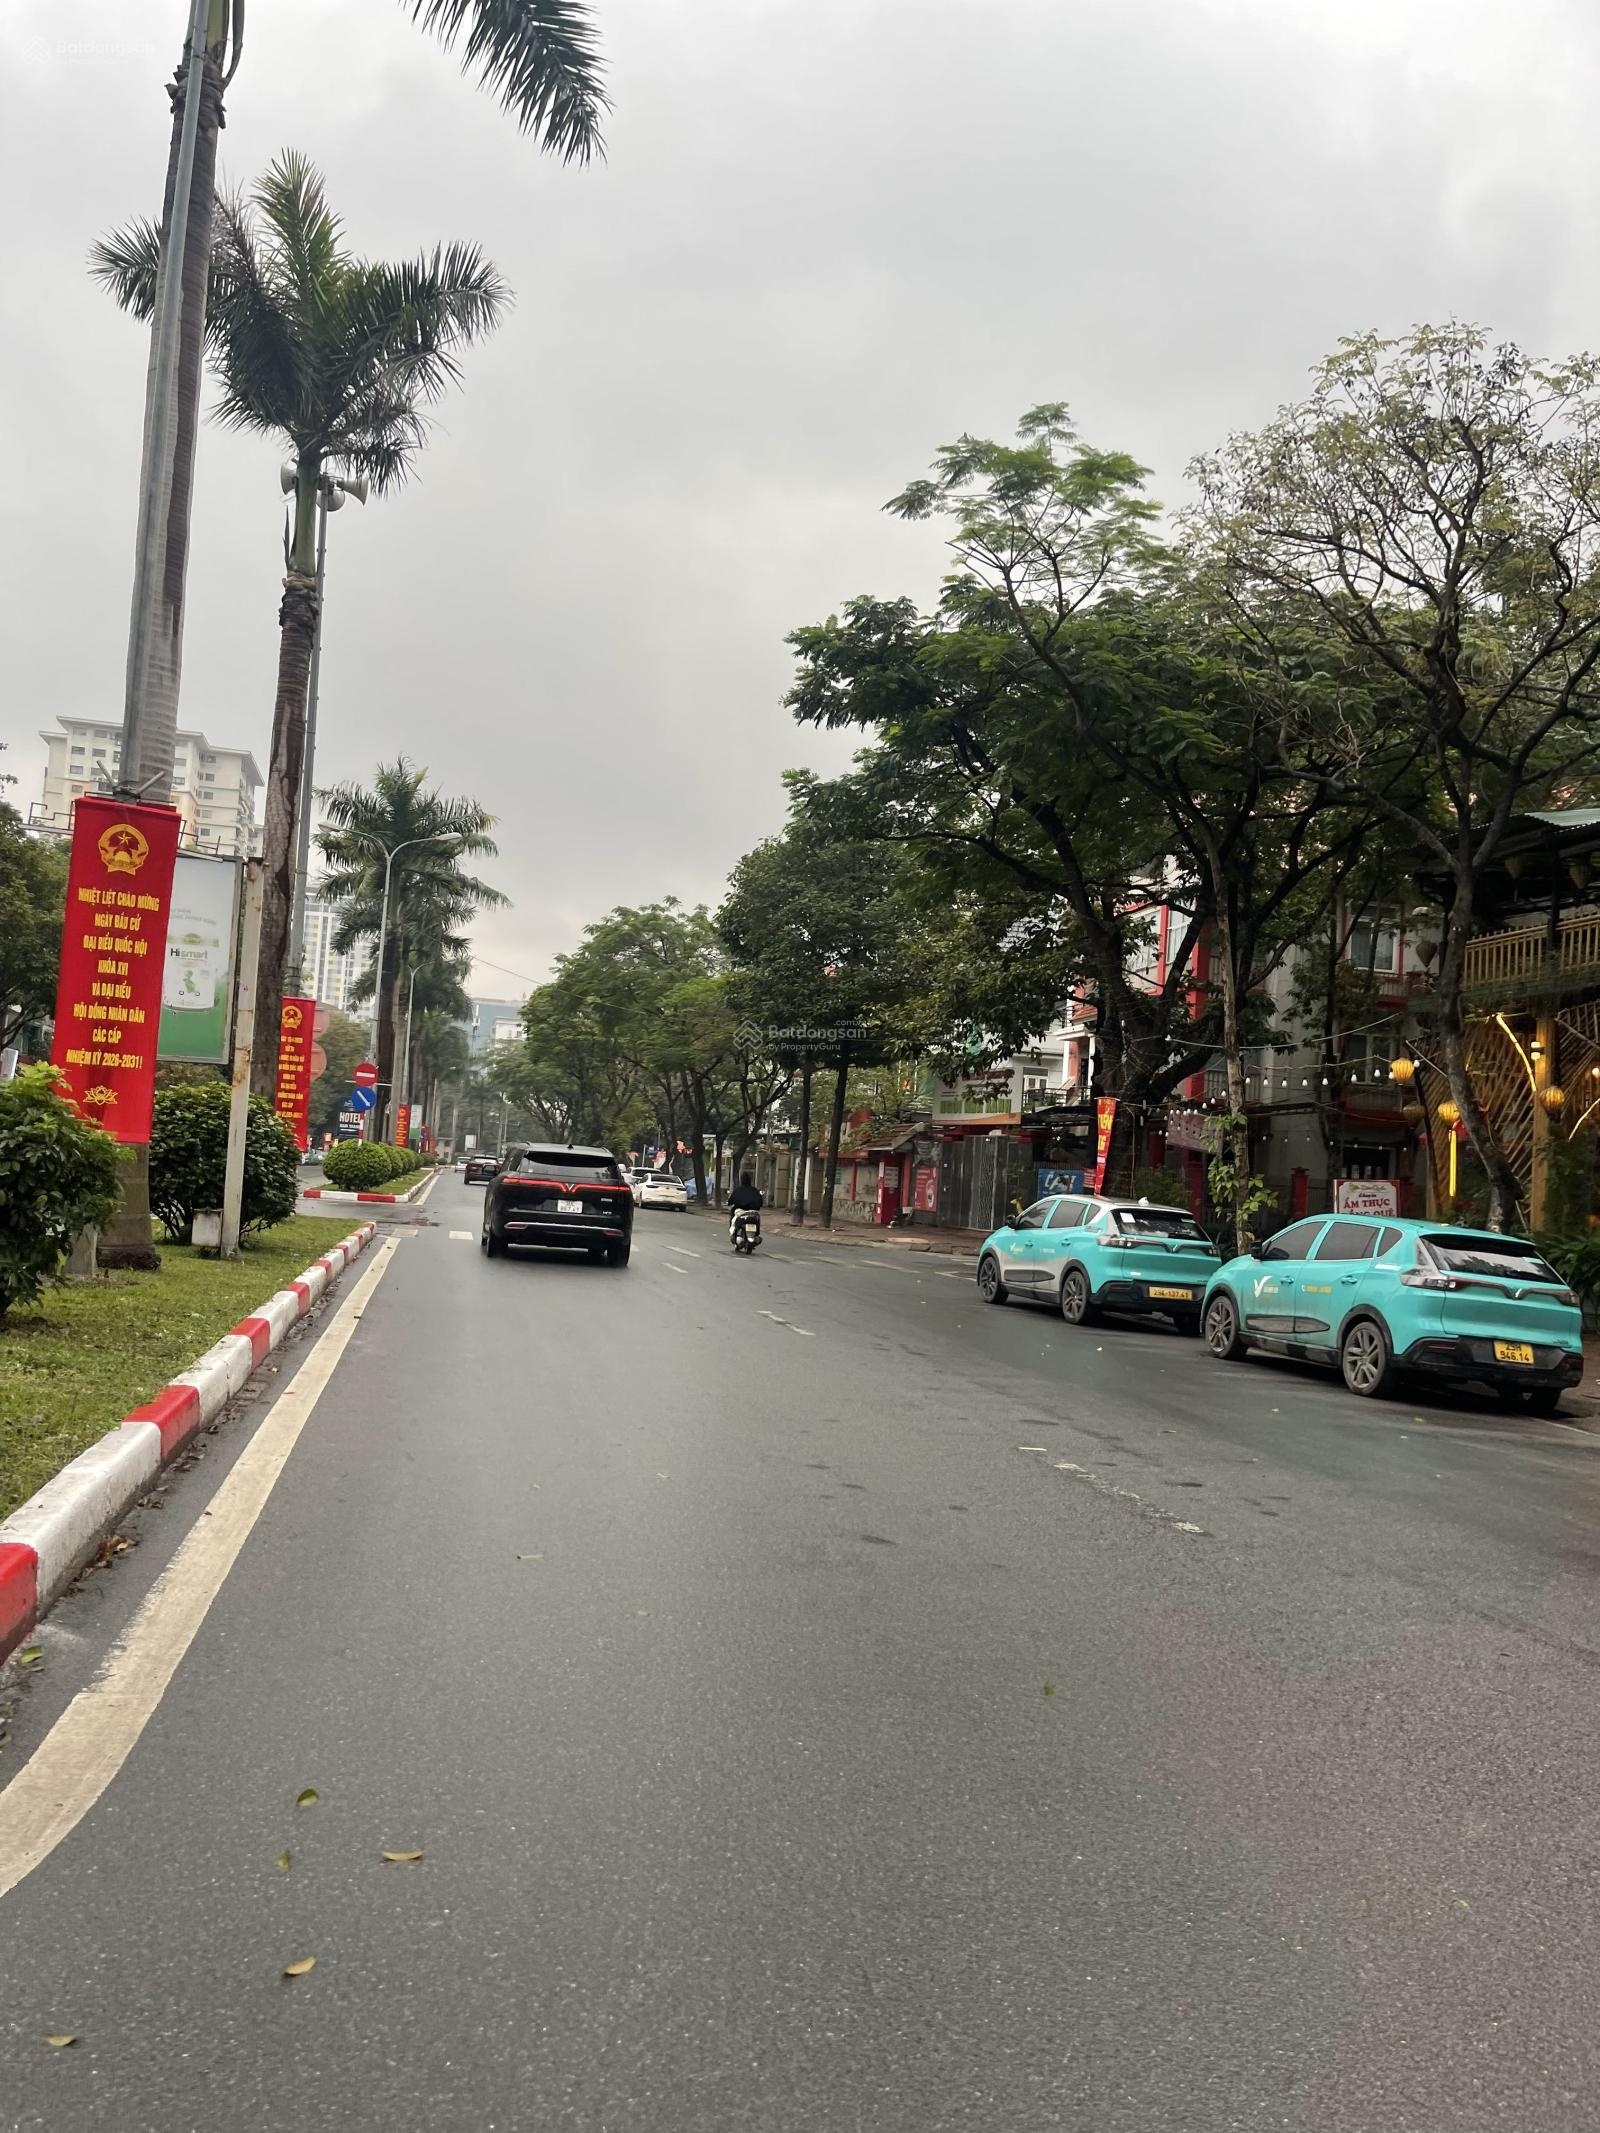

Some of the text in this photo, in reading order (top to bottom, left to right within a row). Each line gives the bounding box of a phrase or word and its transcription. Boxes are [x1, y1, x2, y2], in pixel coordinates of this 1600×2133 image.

[78, 887, 160, 911] NHIỆT LIỆT CHÀO MỪNG
[95, 911, 113, 928] NGÀY
[130, 914, 141, 931] CỬ
[83, 932, 148, 957] ĐẠI BIỂU QUỐC HỘI
[98, 957, 129, 976] KHÓA XVI
[92, 980, 131, 999] VÀ ĐẠI BIỂU
[73, 1001, 87, 1020] HỘI
[108, 1005, 128, 1022] NHÂN
[129, 1007, 145, 1024] DÂN
[92, 1026, 122, 1044] CÁC CẤP
[66, 1048, 91, 1067] NHIỆM
[91, 1049, 102, 1066] KỲ
[1362, 1198, 1390, 1208] THỰC
[1500, 1351, 1530, 1362] 946.14
